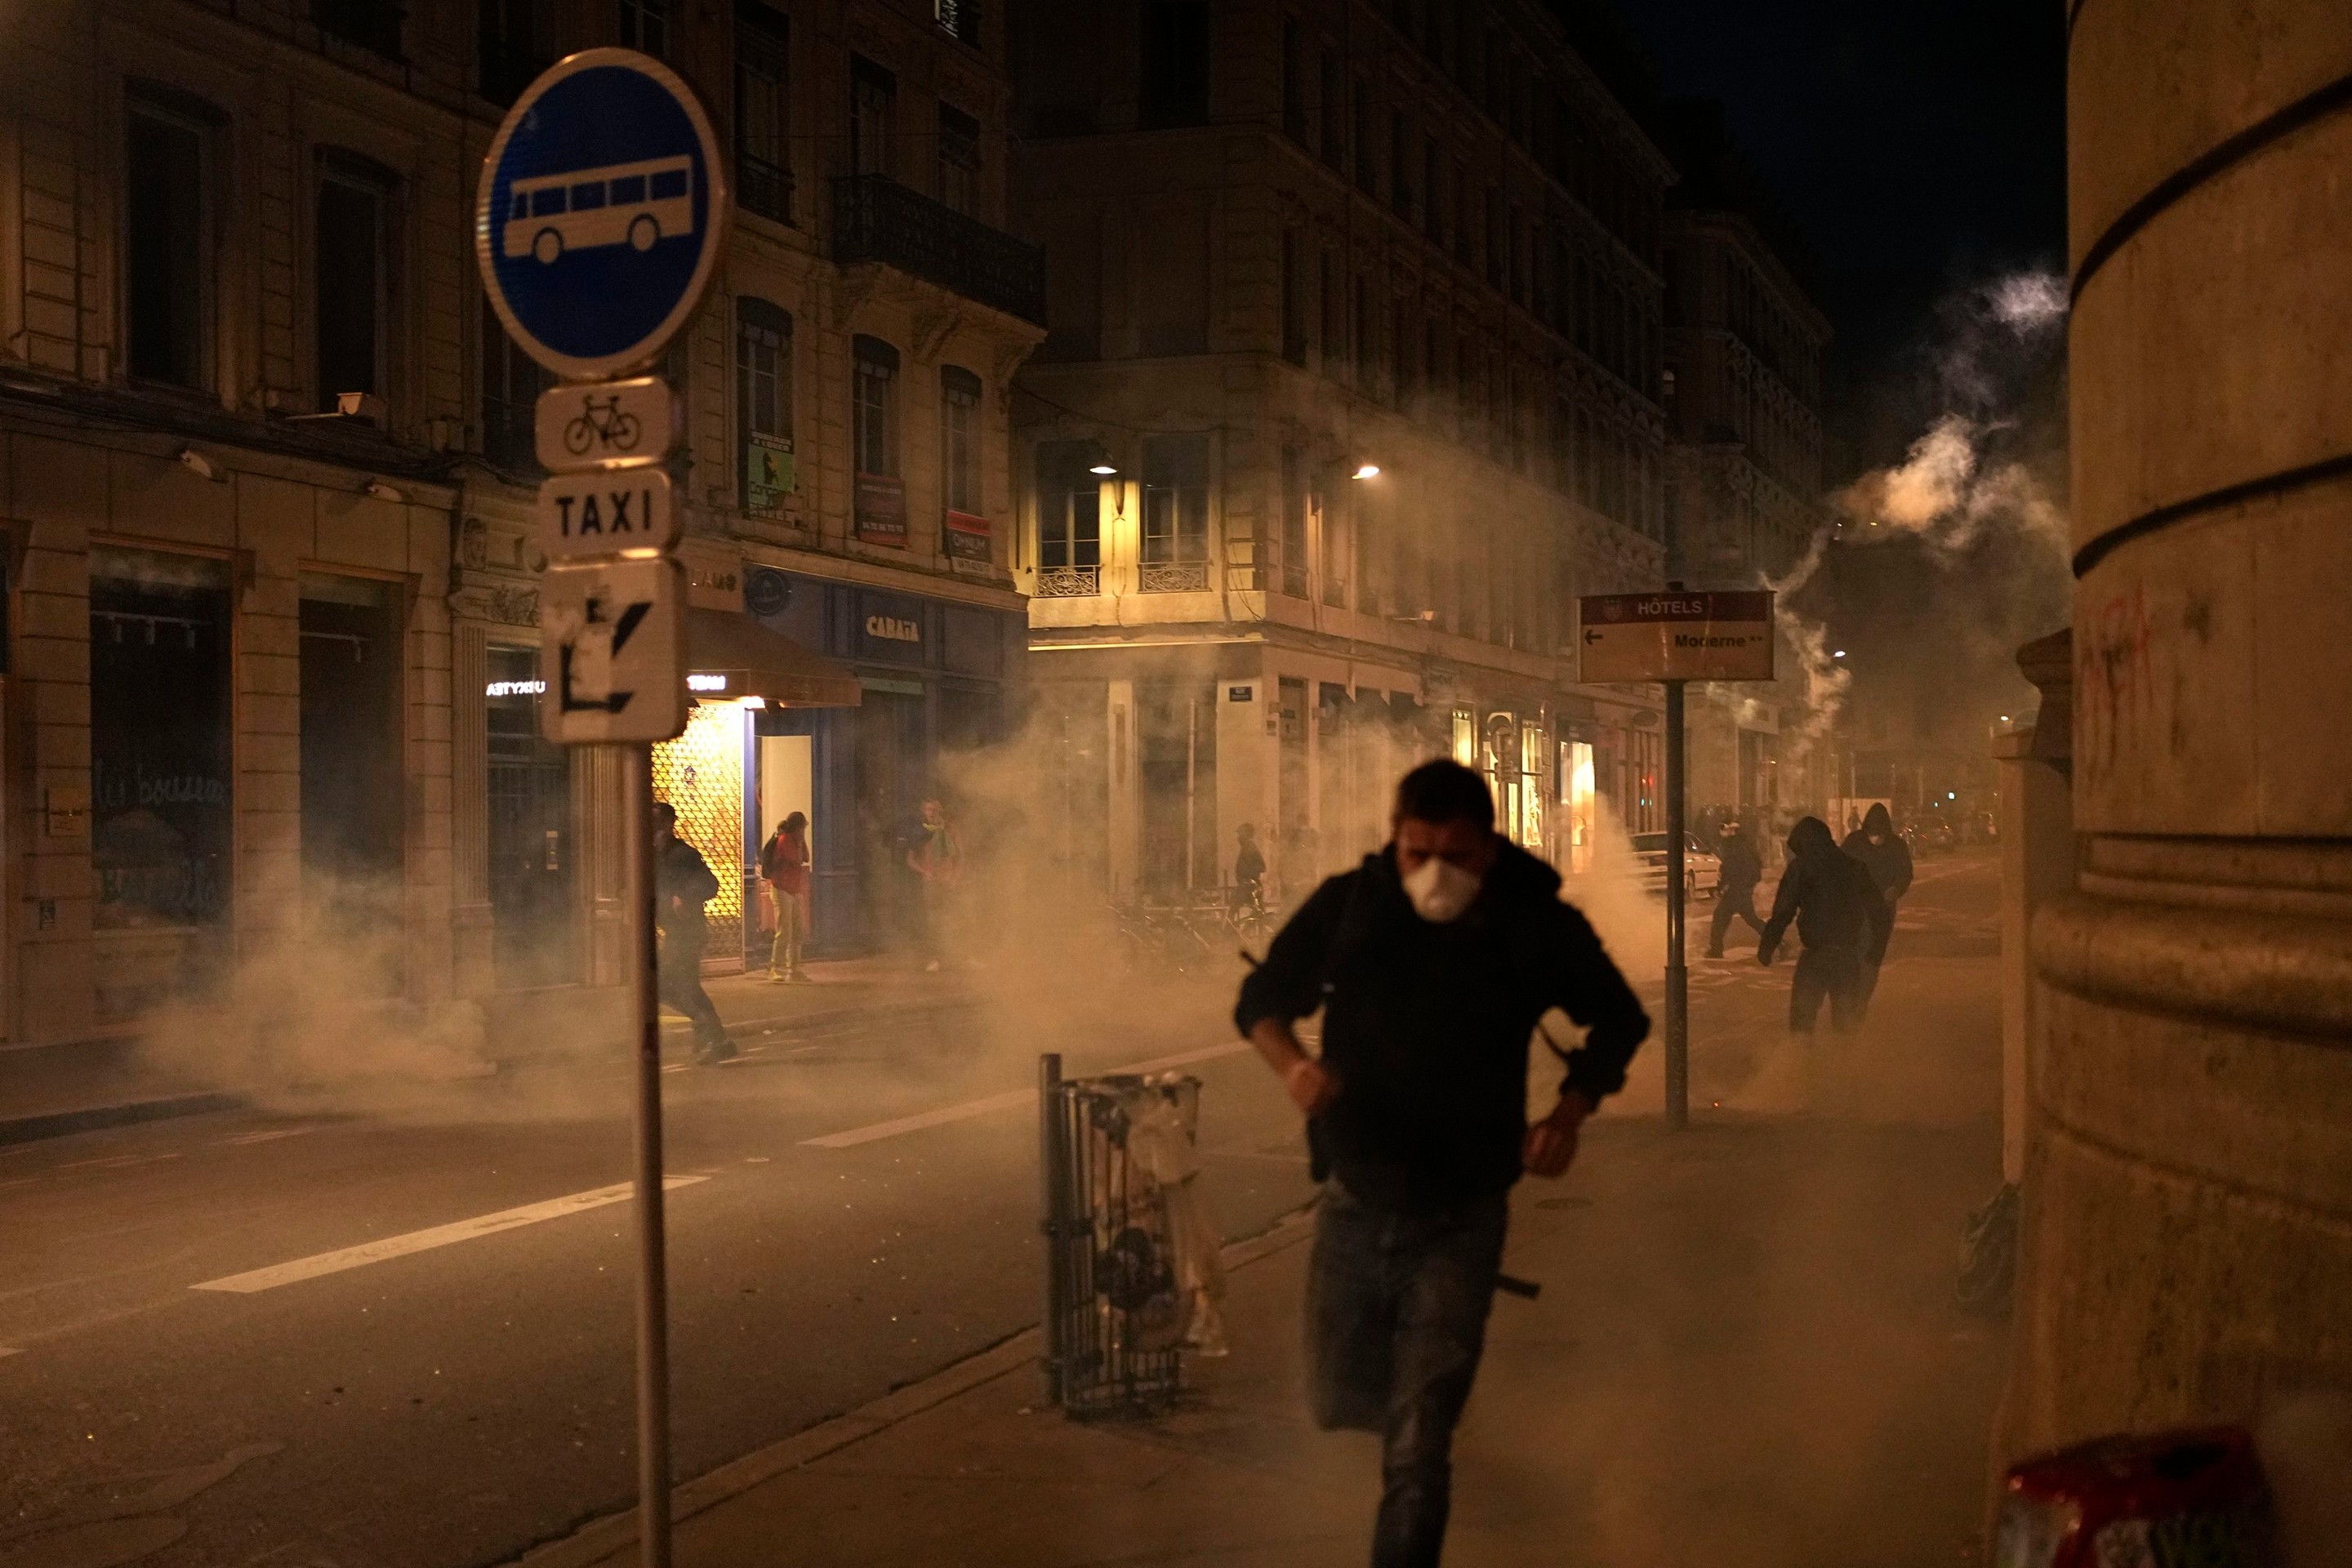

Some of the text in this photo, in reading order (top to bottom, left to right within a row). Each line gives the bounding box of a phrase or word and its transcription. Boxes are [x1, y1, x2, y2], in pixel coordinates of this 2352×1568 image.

[555, 488, 652, 537] TAXI
[1638, 598, 1703, 615] HÔTELS
[1675, 635, 1746, 648] Moderne
